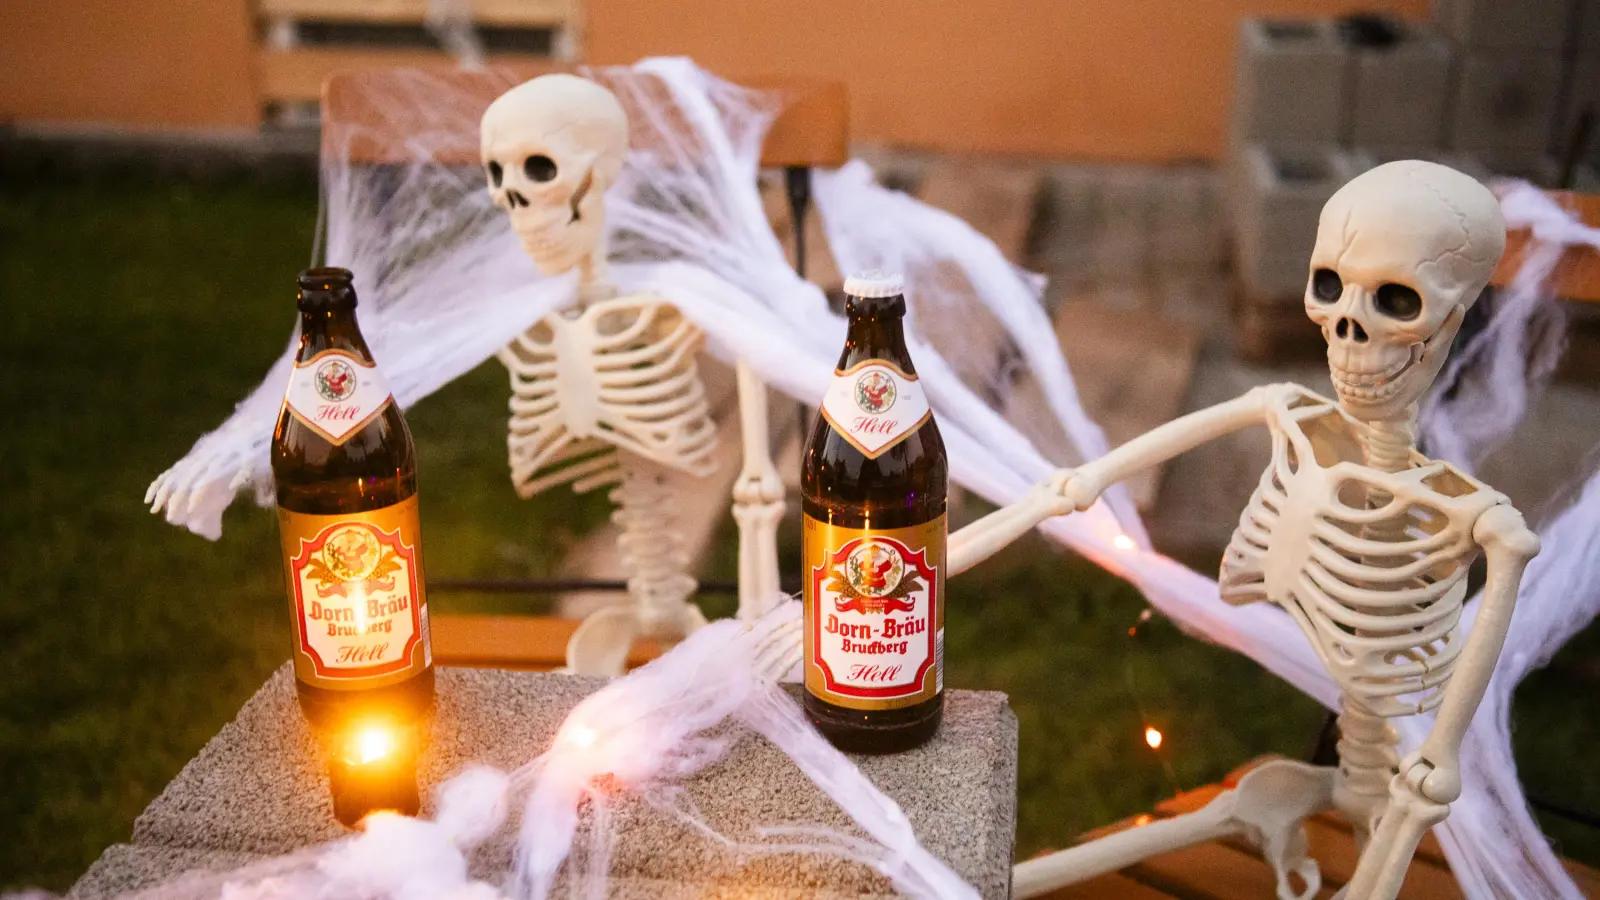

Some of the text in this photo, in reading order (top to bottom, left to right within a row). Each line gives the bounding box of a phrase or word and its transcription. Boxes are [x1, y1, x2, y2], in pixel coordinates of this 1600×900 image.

[314, 405, 360, 421] Hell
[850, 416, 898, 434] Hell
[308, 594, 408, 622] DornBräu
[824, 613, 926, 639] Dorn-Bräu
[335, 642, 390, 664] Hell
[841, 638, 909, 655] Bruckberg
[846, 664, 903, 682] Hell
